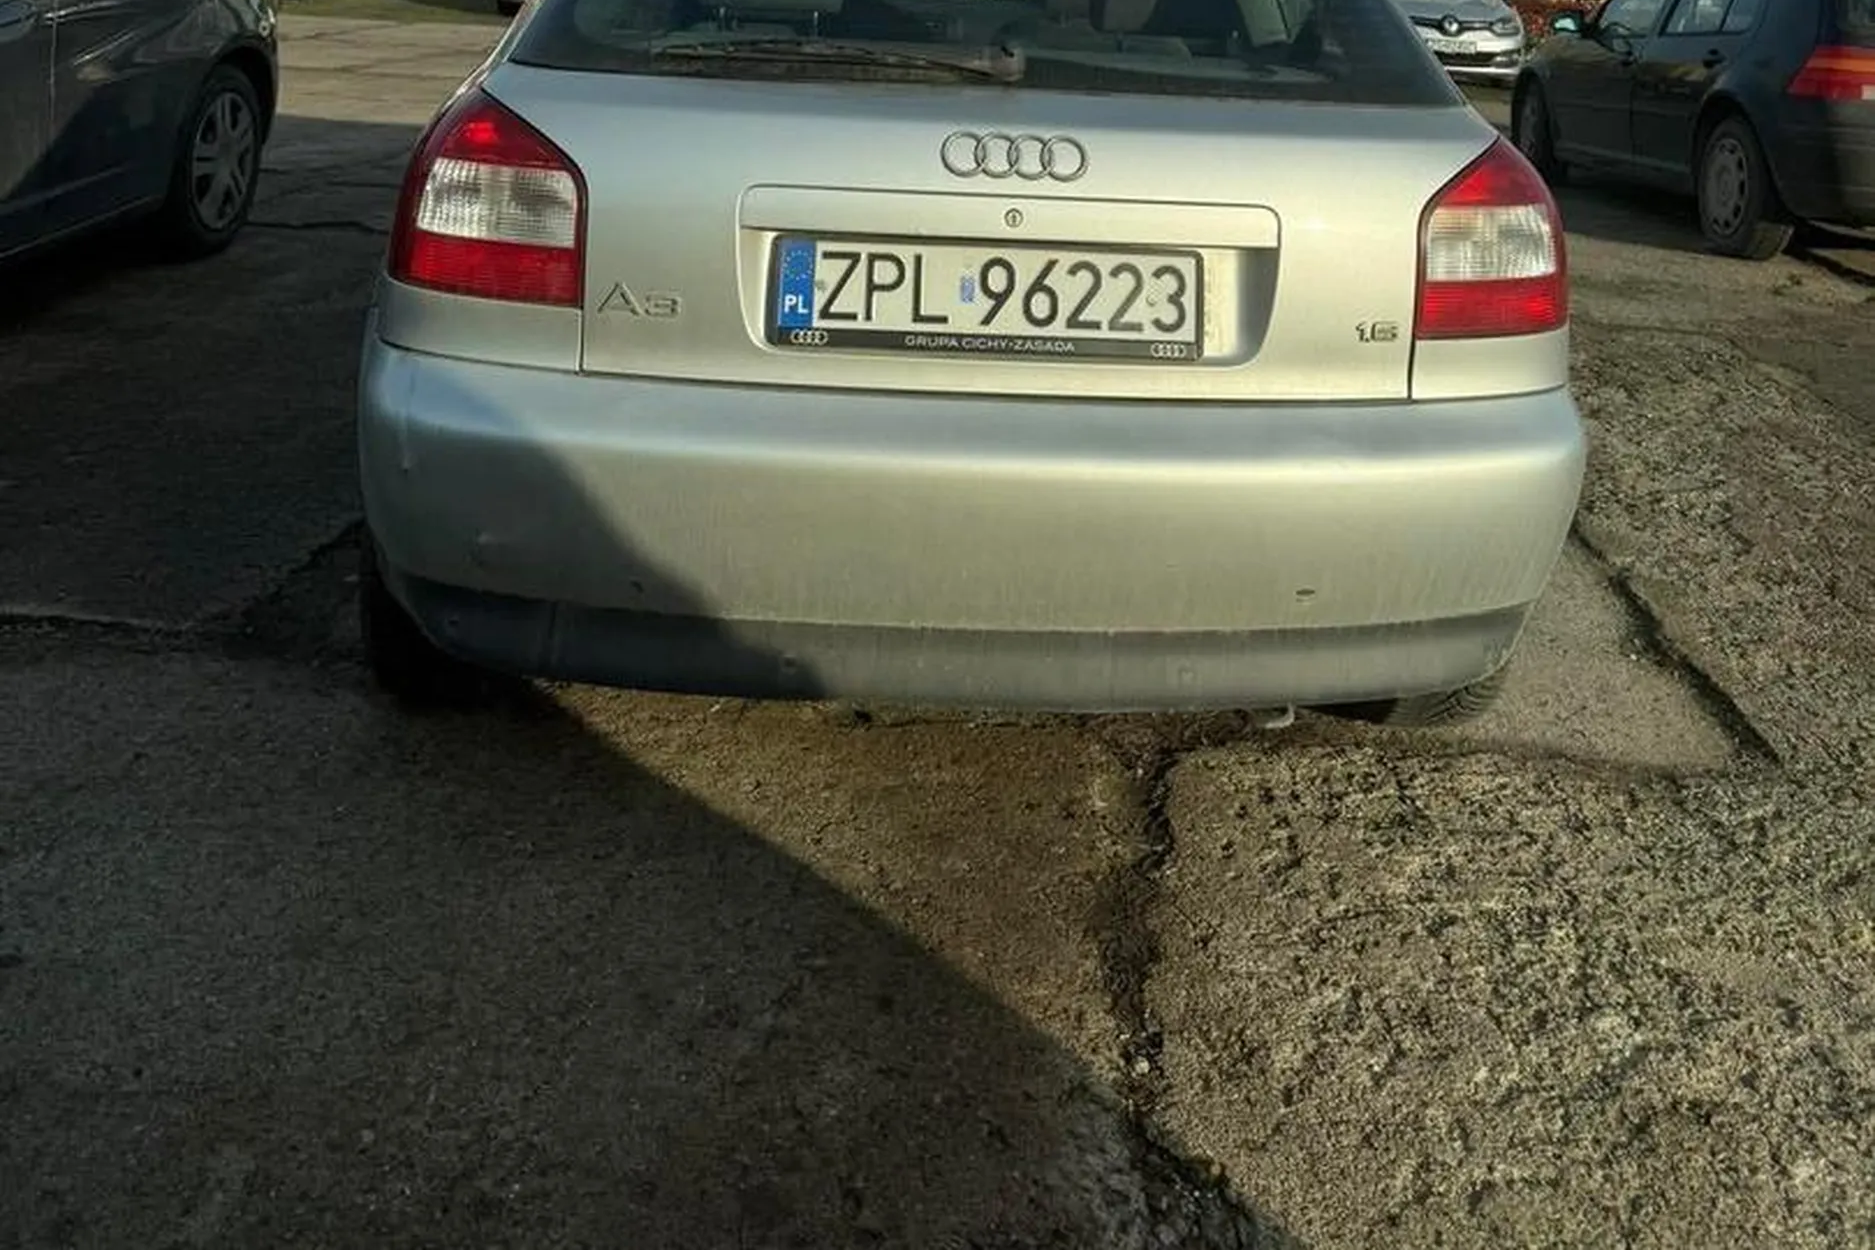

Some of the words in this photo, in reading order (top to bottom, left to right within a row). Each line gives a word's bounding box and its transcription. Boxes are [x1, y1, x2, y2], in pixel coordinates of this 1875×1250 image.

[597, 281, 682, 318] A3
[784, 293, 810, 314] PL
[818, 250, 949, 325] ZPL
[979, 256, 1187, 334] 96223
[904, 334, 959, 348] GRUPA
[1355, 320, 1398, 343] 1.6
